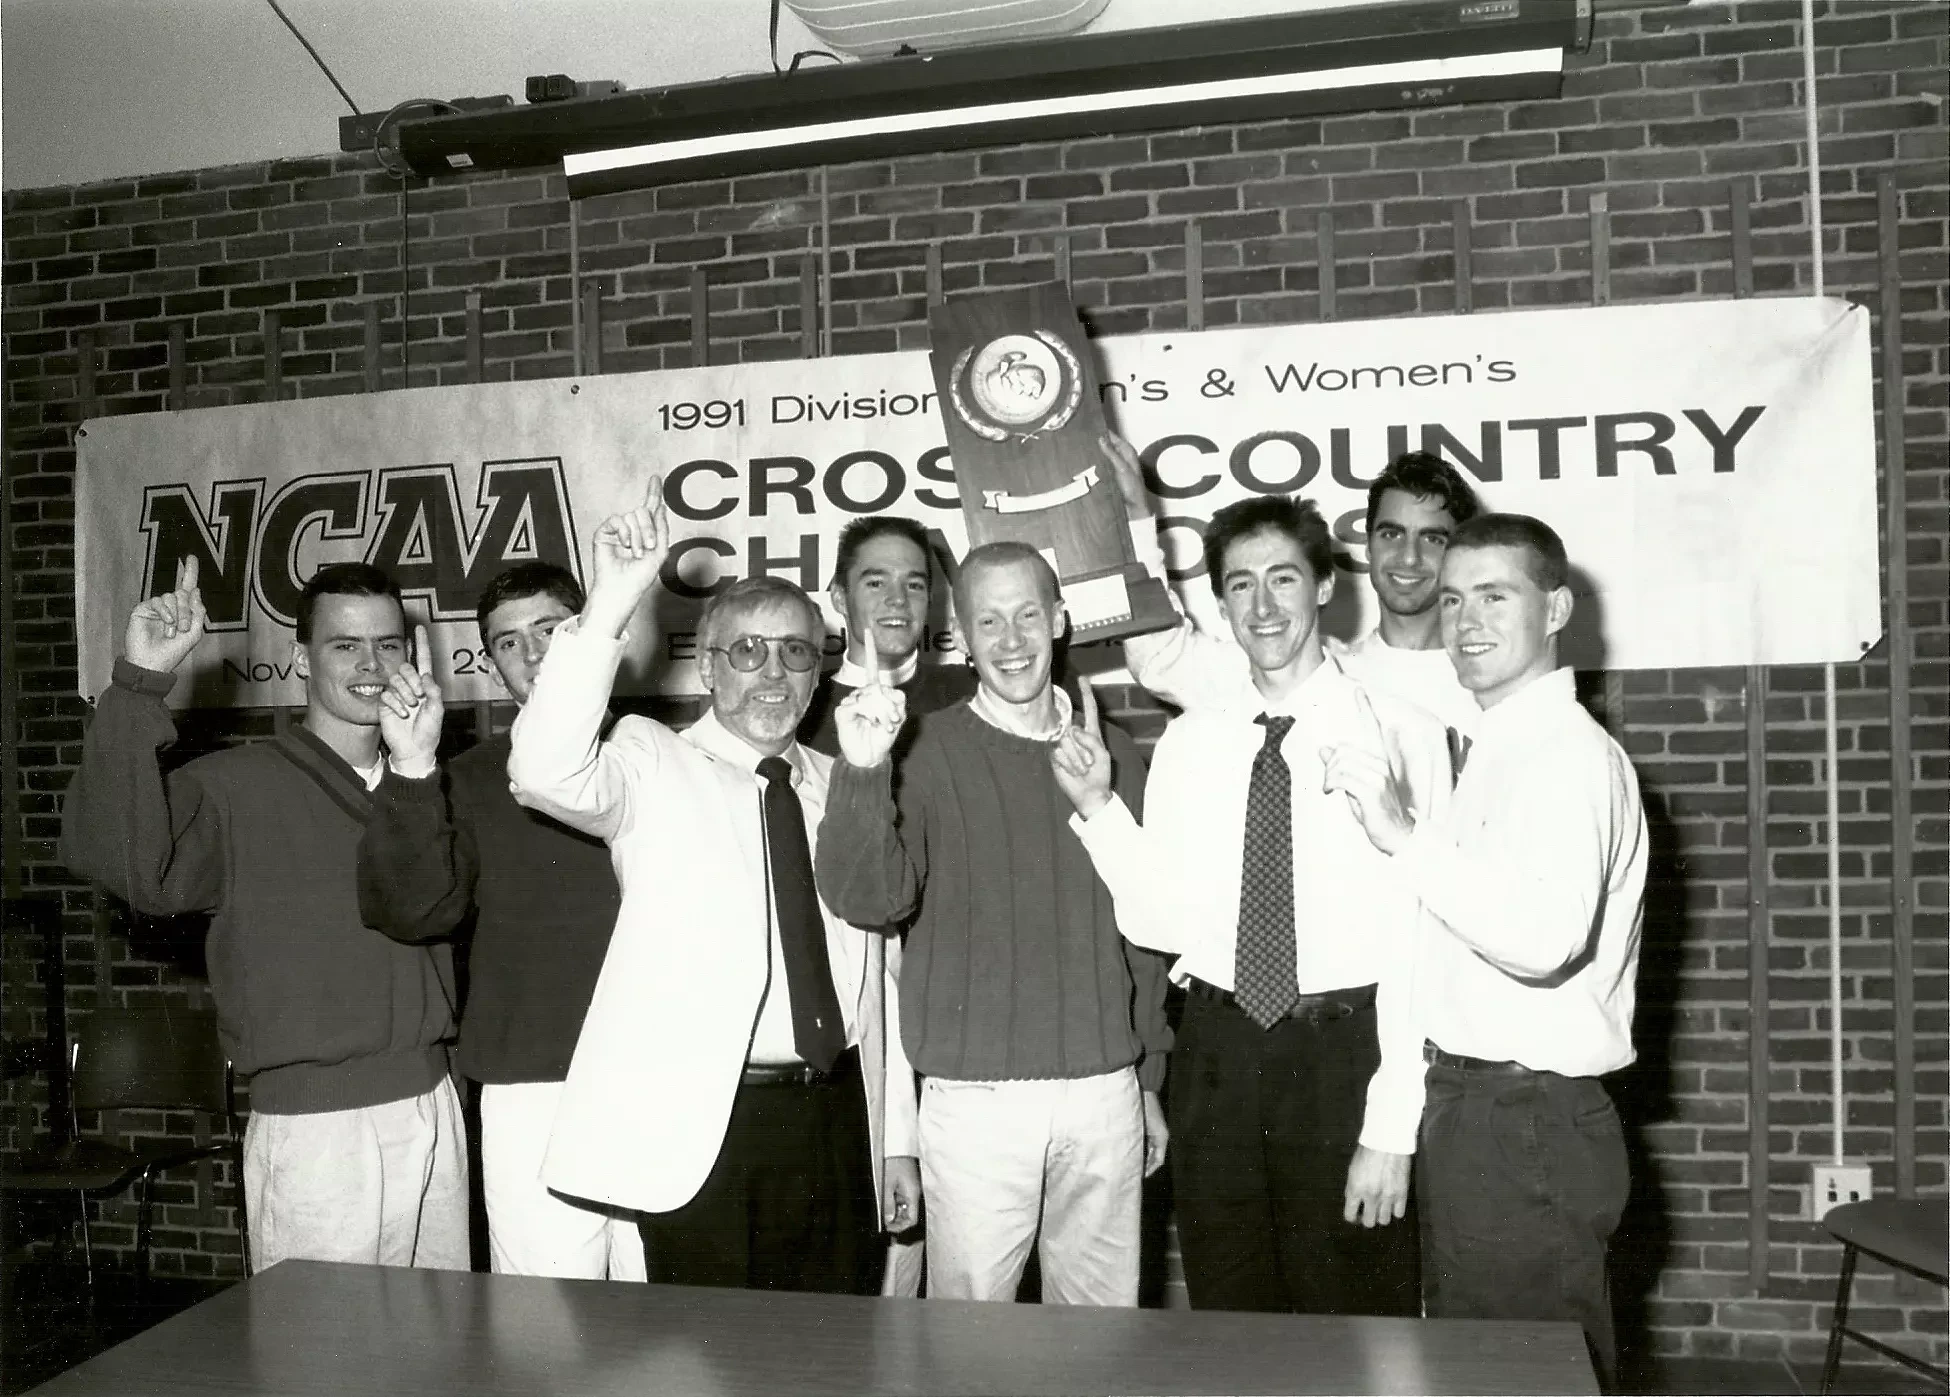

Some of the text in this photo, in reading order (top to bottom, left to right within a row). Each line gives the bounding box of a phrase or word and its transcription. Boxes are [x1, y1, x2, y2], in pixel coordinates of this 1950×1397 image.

[658, 398, 745, 431] 1991
[1200, 368, 1236, 398] &
[1265, 354, 1517, 393] Women's
[662, 405, 1766, 522] CROS COUNTRY
[138, 456, 588, 633] NCAA
